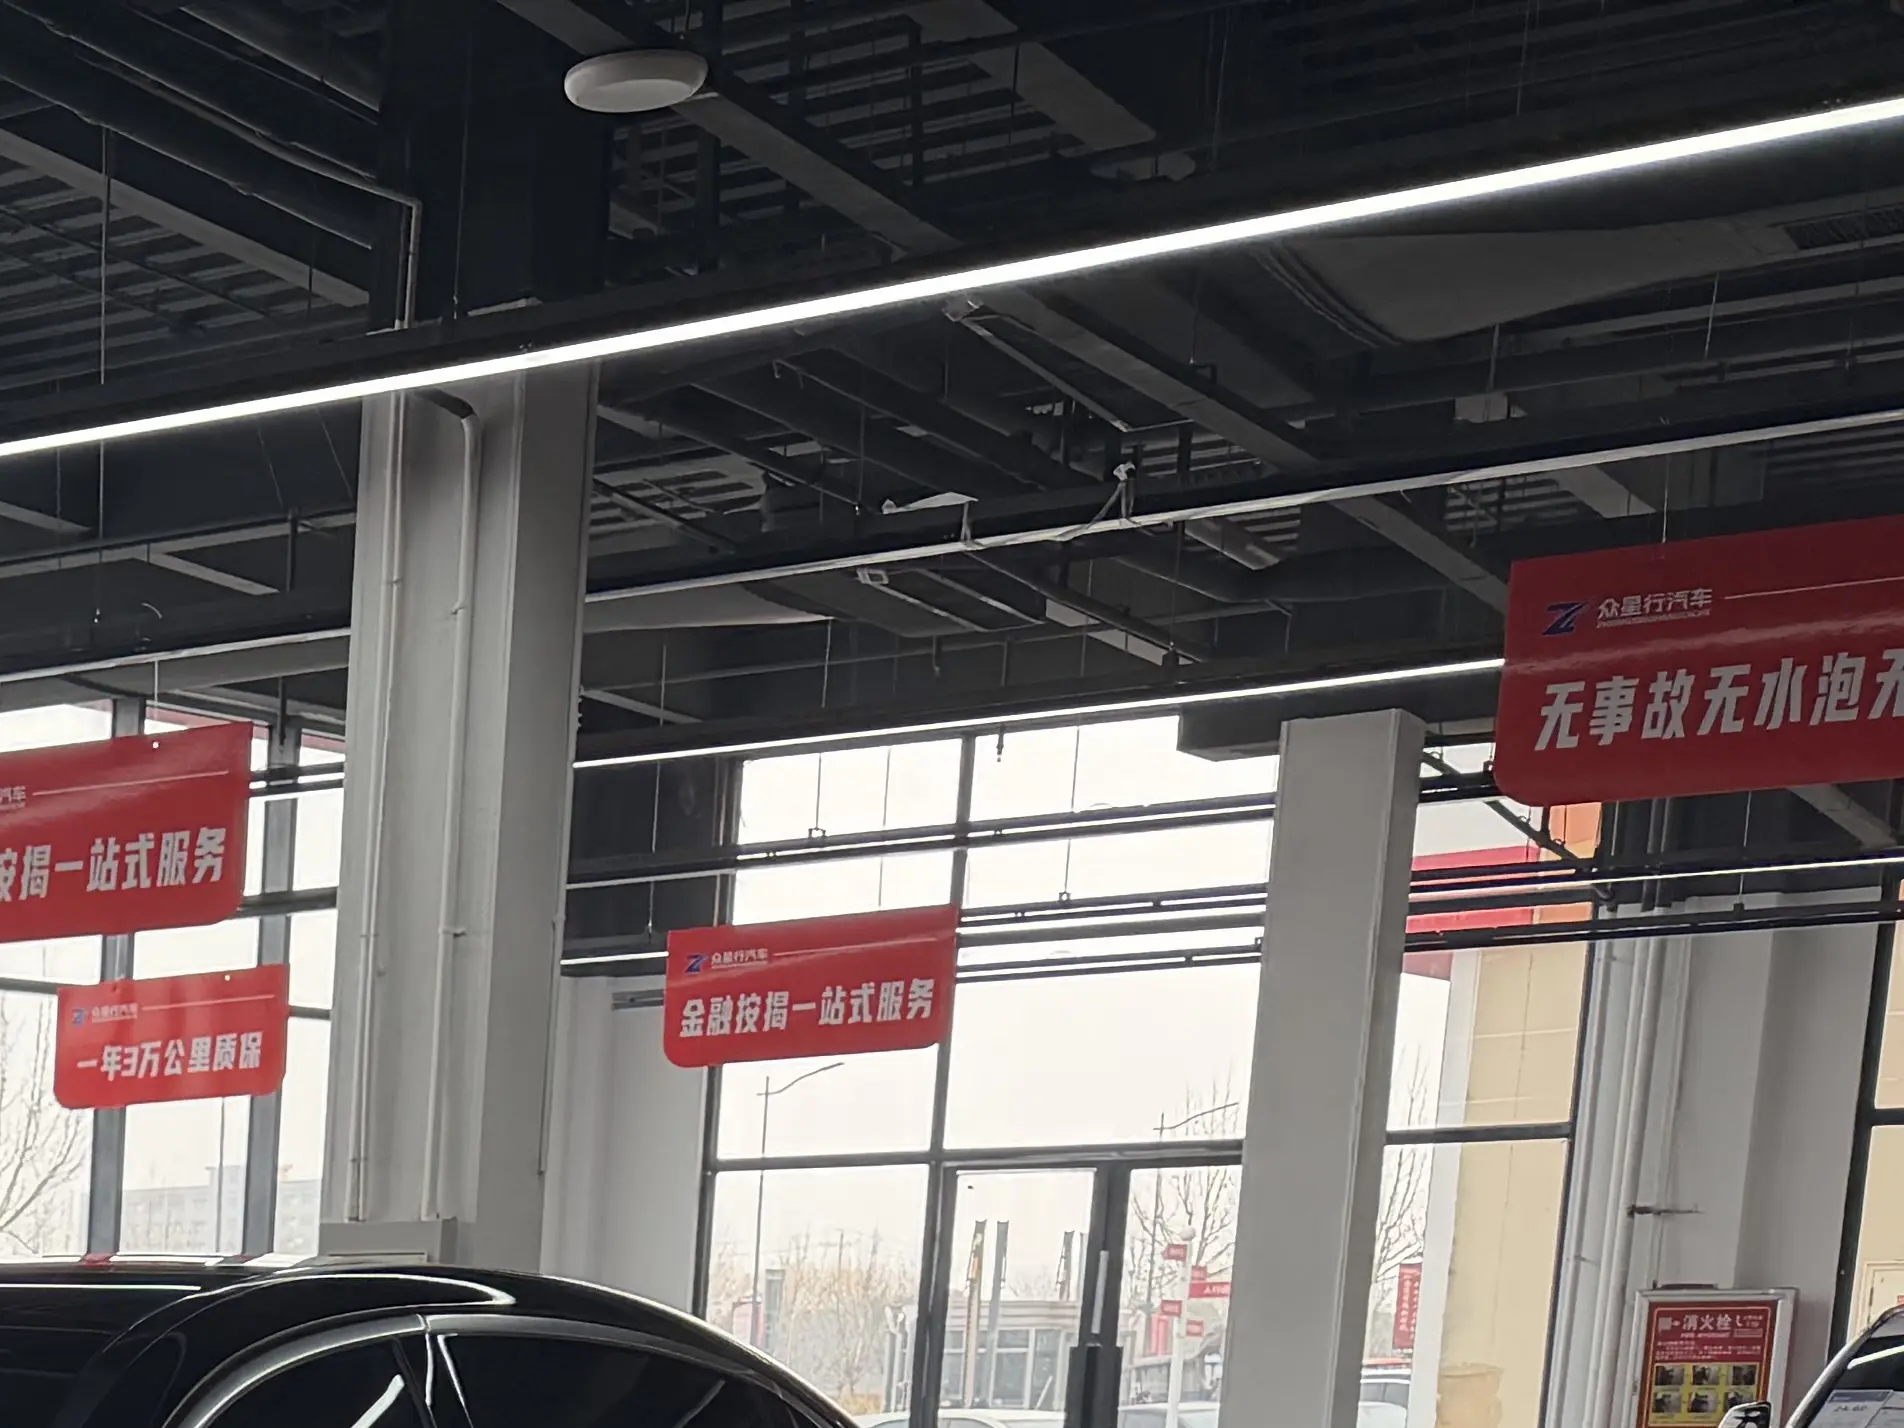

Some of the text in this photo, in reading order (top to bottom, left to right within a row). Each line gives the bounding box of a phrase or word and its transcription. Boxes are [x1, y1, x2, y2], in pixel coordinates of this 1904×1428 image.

[1597, 588, 1712, 620] 众星行汽车
[680, 978, 935, 1038] 金融按揭一站式服务
[77, 1031, 263, 1081] 一年3万公里质保
[1682, 1313, 1733, 1331] 消火栓
